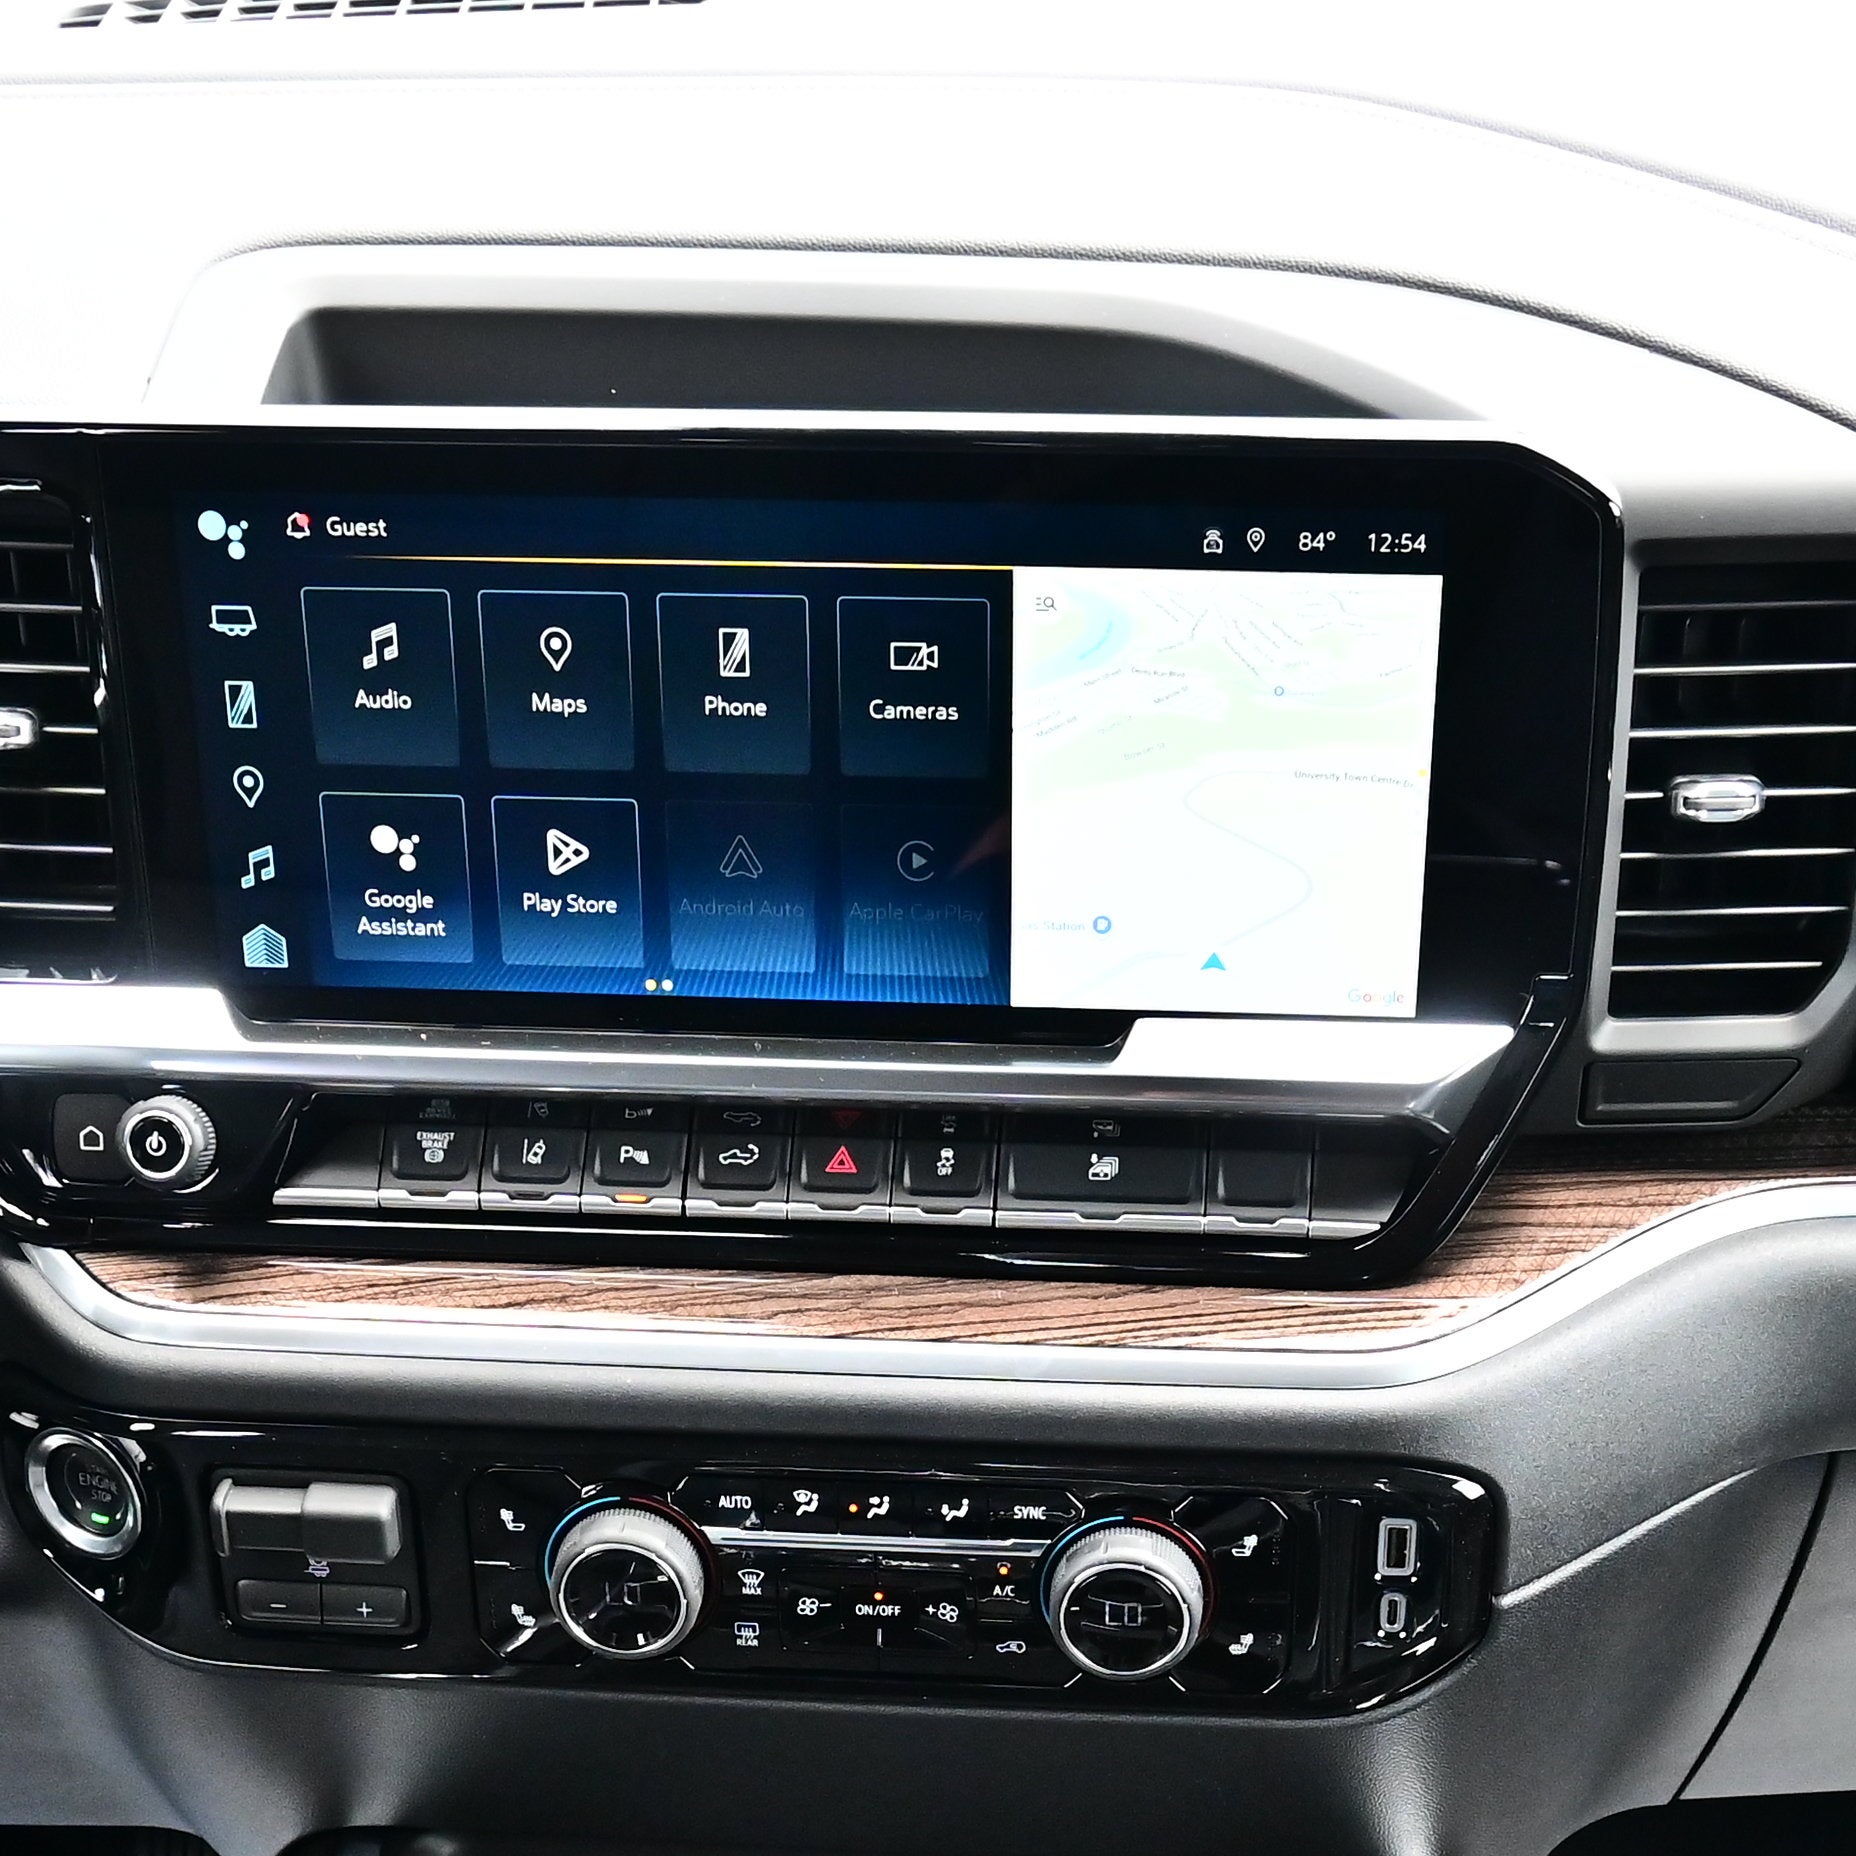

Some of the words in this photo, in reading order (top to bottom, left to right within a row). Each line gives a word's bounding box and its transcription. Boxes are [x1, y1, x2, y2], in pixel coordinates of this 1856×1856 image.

[326, 516, 387, 537] Guest
[1299, 531, 1336, 552] 84°
[1368, 532, 1427, 553] 12:54
[354, 688, 412, 710] Audio
[531, 692, 588, 718] Maps
[704, 695, 767, 717] Phone
[869, 699, 959, 721] Cameras
[364, 889, 435, 914] Google
[523, 891, 562, 918] Play
[567, 893, 618, 915] Store
[679, 898, 755, 916] Android
[758, 901, 805, 918] Auto
[848, 902, 904, 921] Apple
[357, 916, 447, 938] Assistant
[718, 1495, 752, 1510] AUTO
[1013, 1505, 1048, 1521] SYNC
[992, 1584, 1016, 1597] A/C
[855, 1603, 902, 1617] ON/OFF
